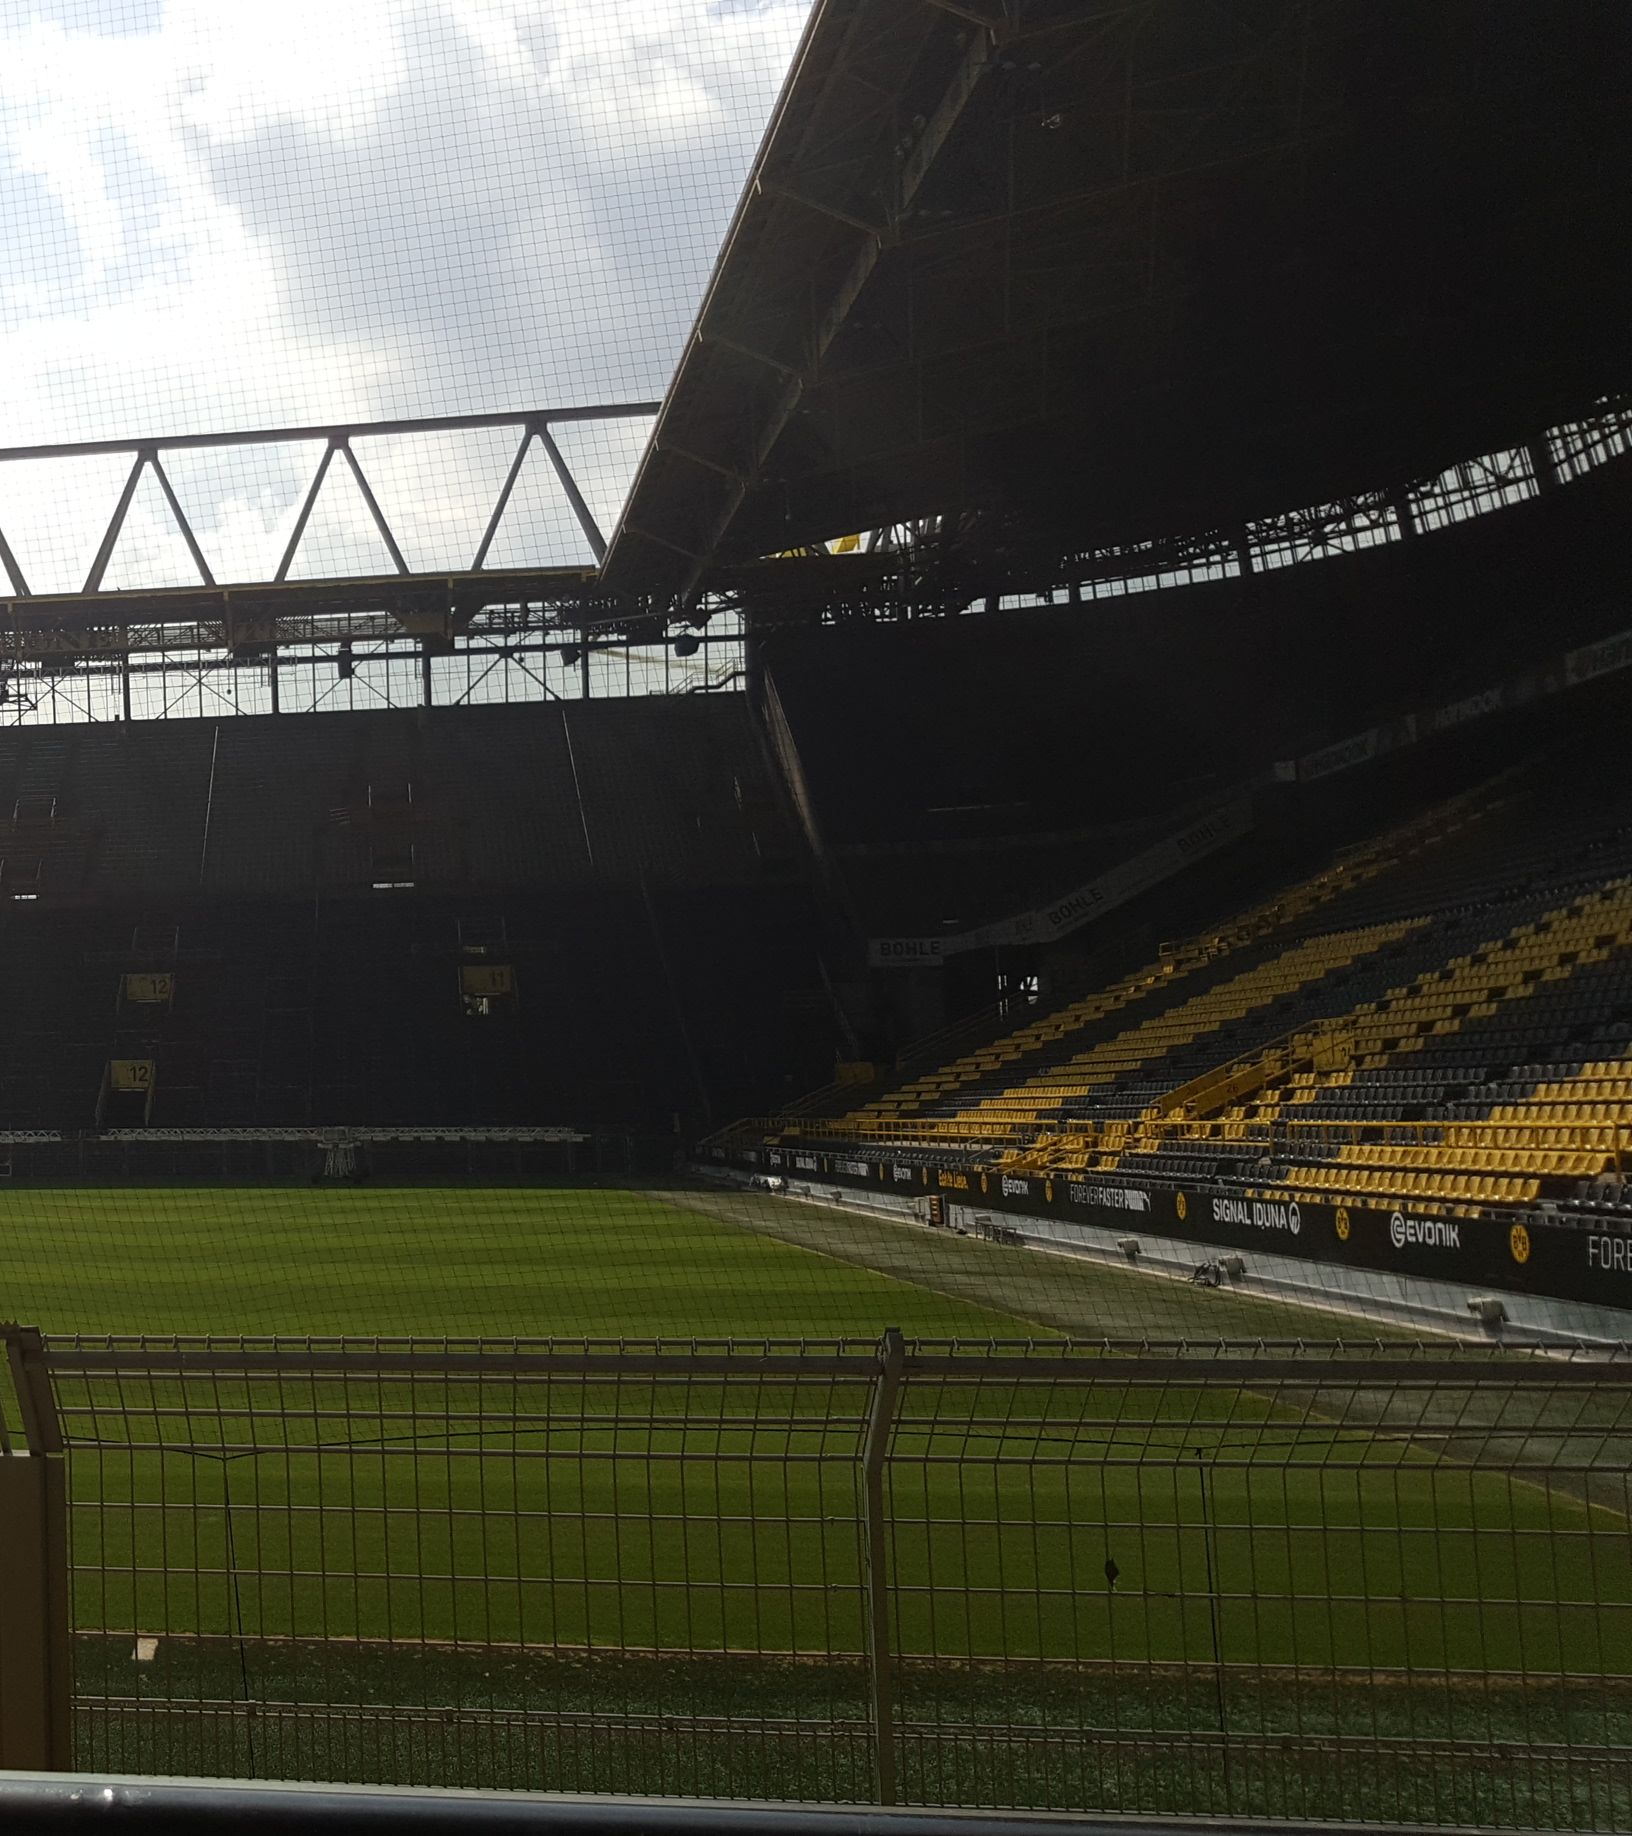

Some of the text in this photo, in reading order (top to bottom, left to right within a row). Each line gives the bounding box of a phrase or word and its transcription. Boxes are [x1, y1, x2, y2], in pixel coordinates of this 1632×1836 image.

[1047, 887, 1104, 926] BOHLE
[879, 940, 941, 957] BOHLE
[151, 978, 168, 995] 12
[489, 971, 504, 988] 11
[129, 1065, 149, 1084] 12
[1212, 1198, 1288, 1230] SIGNAL IDUNA
[1406, 1220, 1461, 1248] EVONIK
[1588, 1235, 1632, 1272] FORE
